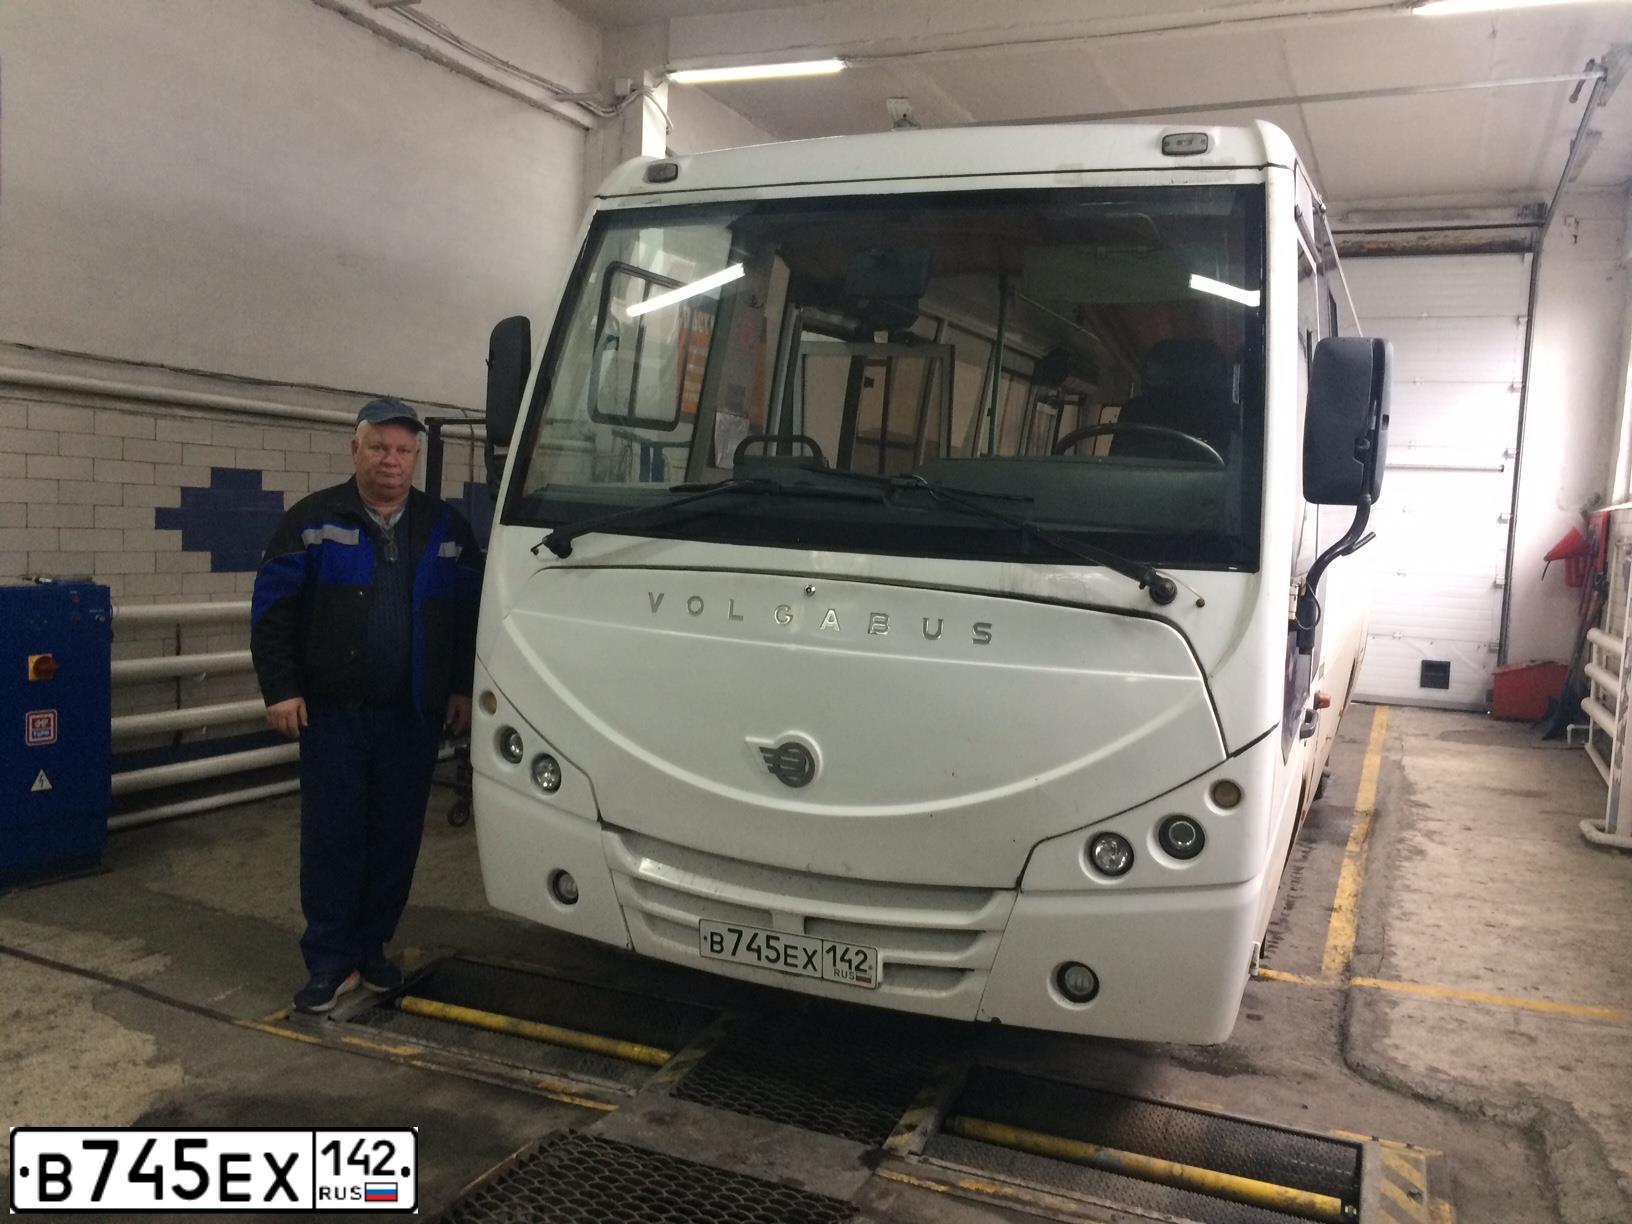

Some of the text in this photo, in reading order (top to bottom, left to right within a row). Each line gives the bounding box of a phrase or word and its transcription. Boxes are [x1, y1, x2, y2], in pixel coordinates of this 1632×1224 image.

[648, 591, 993, 646] VOLGABUS
[825, 944, 868, 973] 142
[833, 968, 855, 981] RUS
